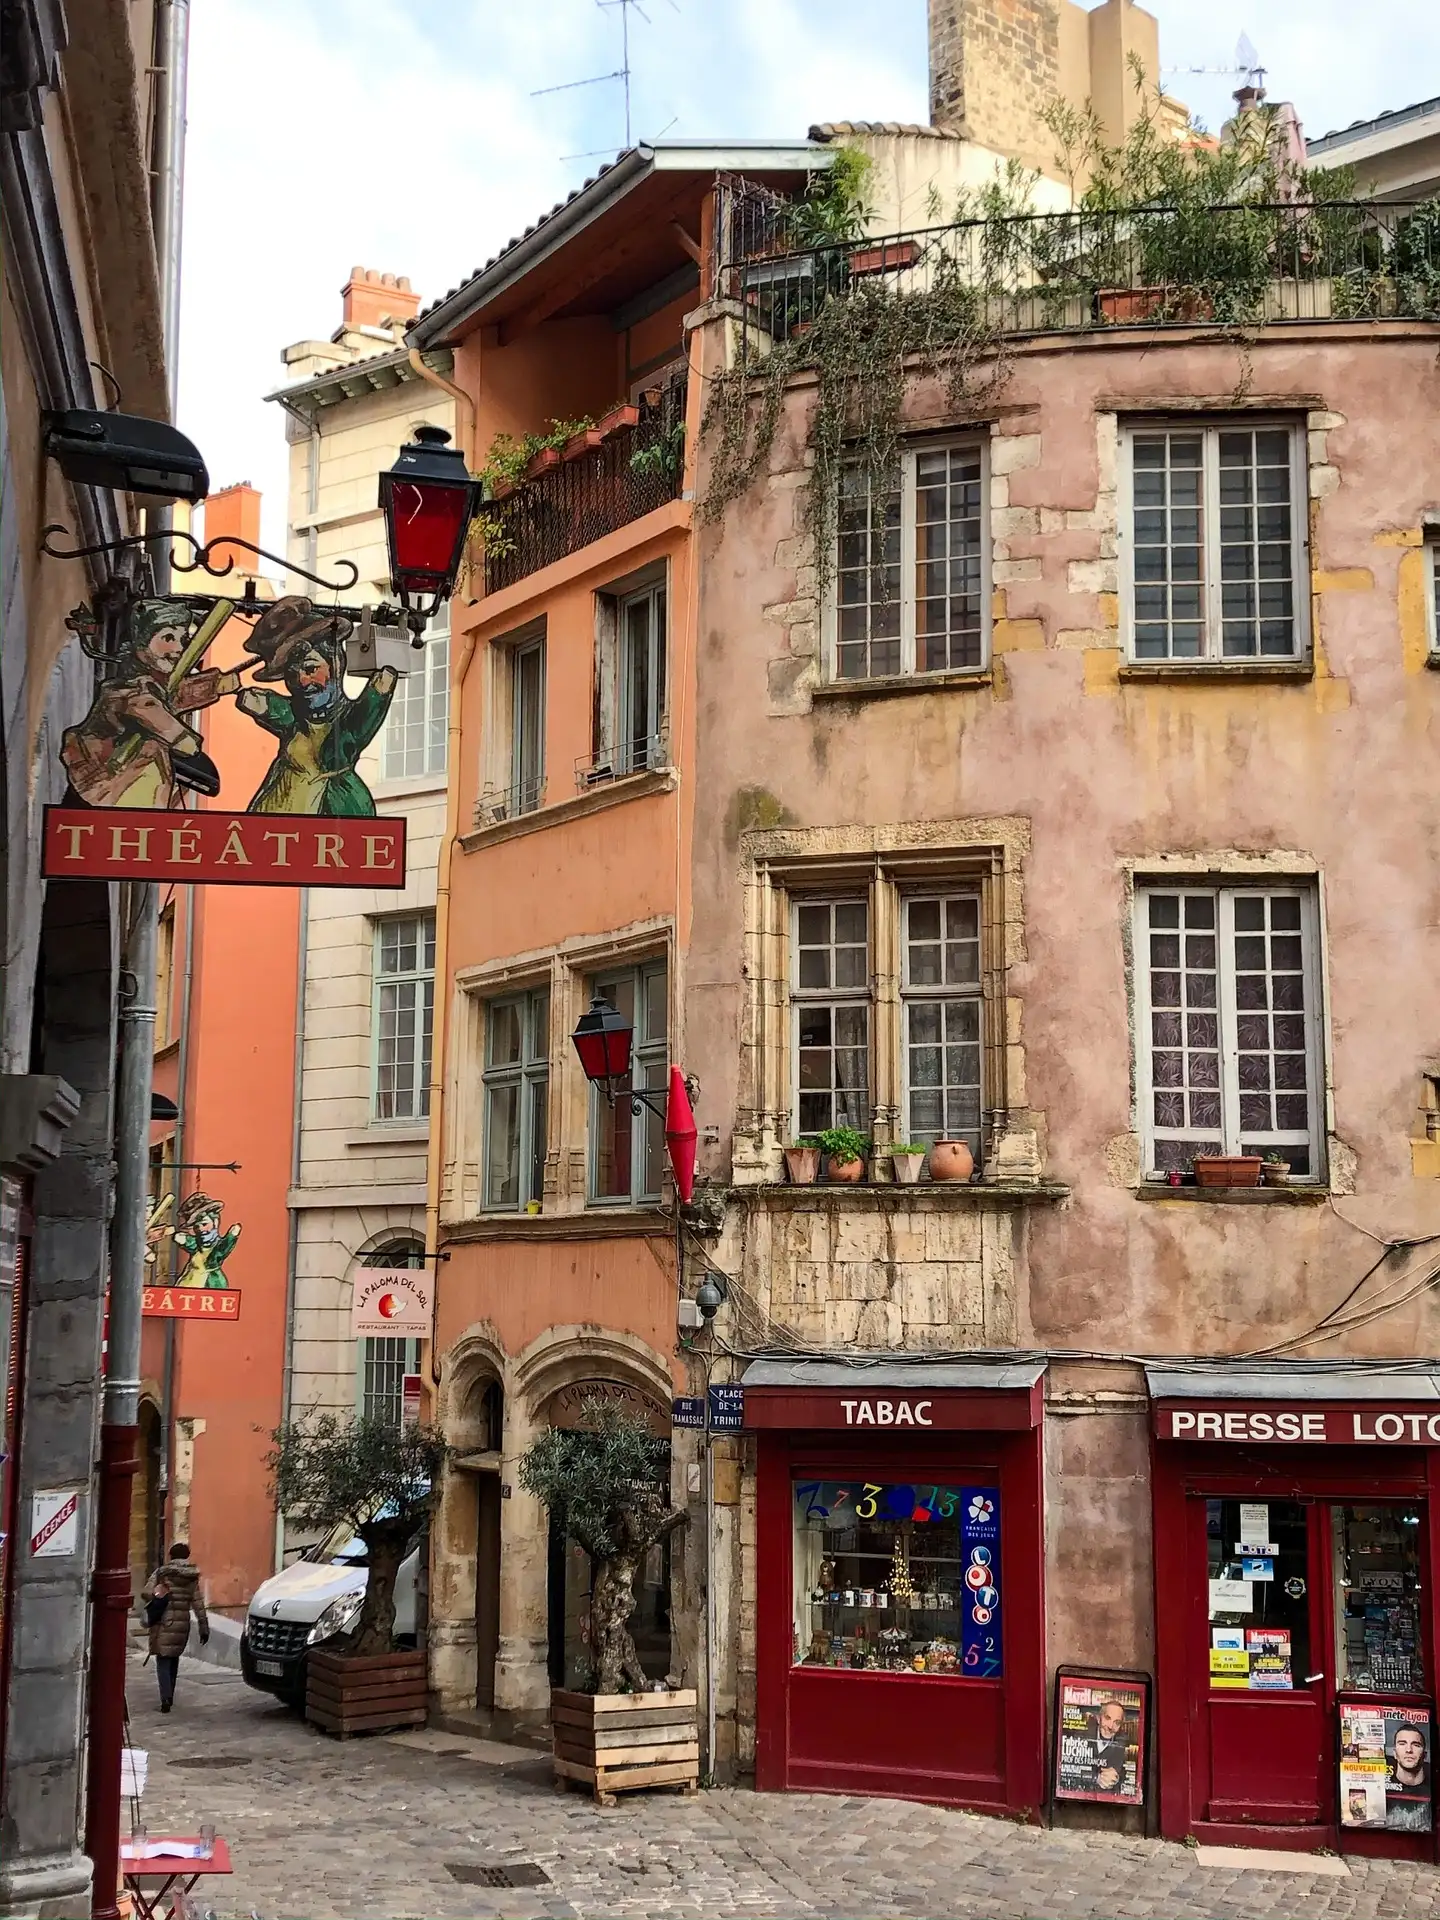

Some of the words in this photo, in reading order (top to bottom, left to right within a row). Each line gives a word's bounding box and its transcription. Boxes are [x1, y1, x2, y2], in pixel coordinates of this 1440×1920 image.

[55, 819, 396, 870] THÉÂTRE
[356, 1295, 368, 1308] LA
[365, 1276, 399, 1295] PALOMA
[400, 1277, 416, 1293] DEL
[416, 1290, 428, 1309] SOL
[142, 1288, 236, 1313] ÉÂTRE
[718, 1389, 744, 1398] PLACE
[560, 1393, 573, 1412] LA
[570, 1384, 610, 1401] PALOMA
[611, 1385, 637, 1402] DEL
[641, 1394, 668, 1420] SOL
[681, 1401, 693, 1411] RUE
[718, 1402, 729, 1410] DE
[733, 1402, 744, 1411] LA
[671, 1413, 704, 1425] TRAMASSAC
[840, 1400, 933, 1425] TABAC
[713, 1415, 743, 1426] TRINIT
[1172, 1411, 1327, 1440] PRESSE
[855, 1482, 883, 1518] 3
[36, 1500, 74, 1548] LICENCE
[1241, 1544, 1275, 1554] LOTO
[965, 1546, 998, 1625] LOTO
[1362, 1577, 1401, 1587] LYON
[985, 1637, 994, 1652] 2
[964, 1644, 981, 1666] 5
[1407, 1711, 1428, 1724] Lyon
[1062, 1735, 1088, 1748] Fabrice
[1062, 1745, 1093, 1758] LUCHINI
[1344, 1764, 1377, 1772] NOUVEAU
